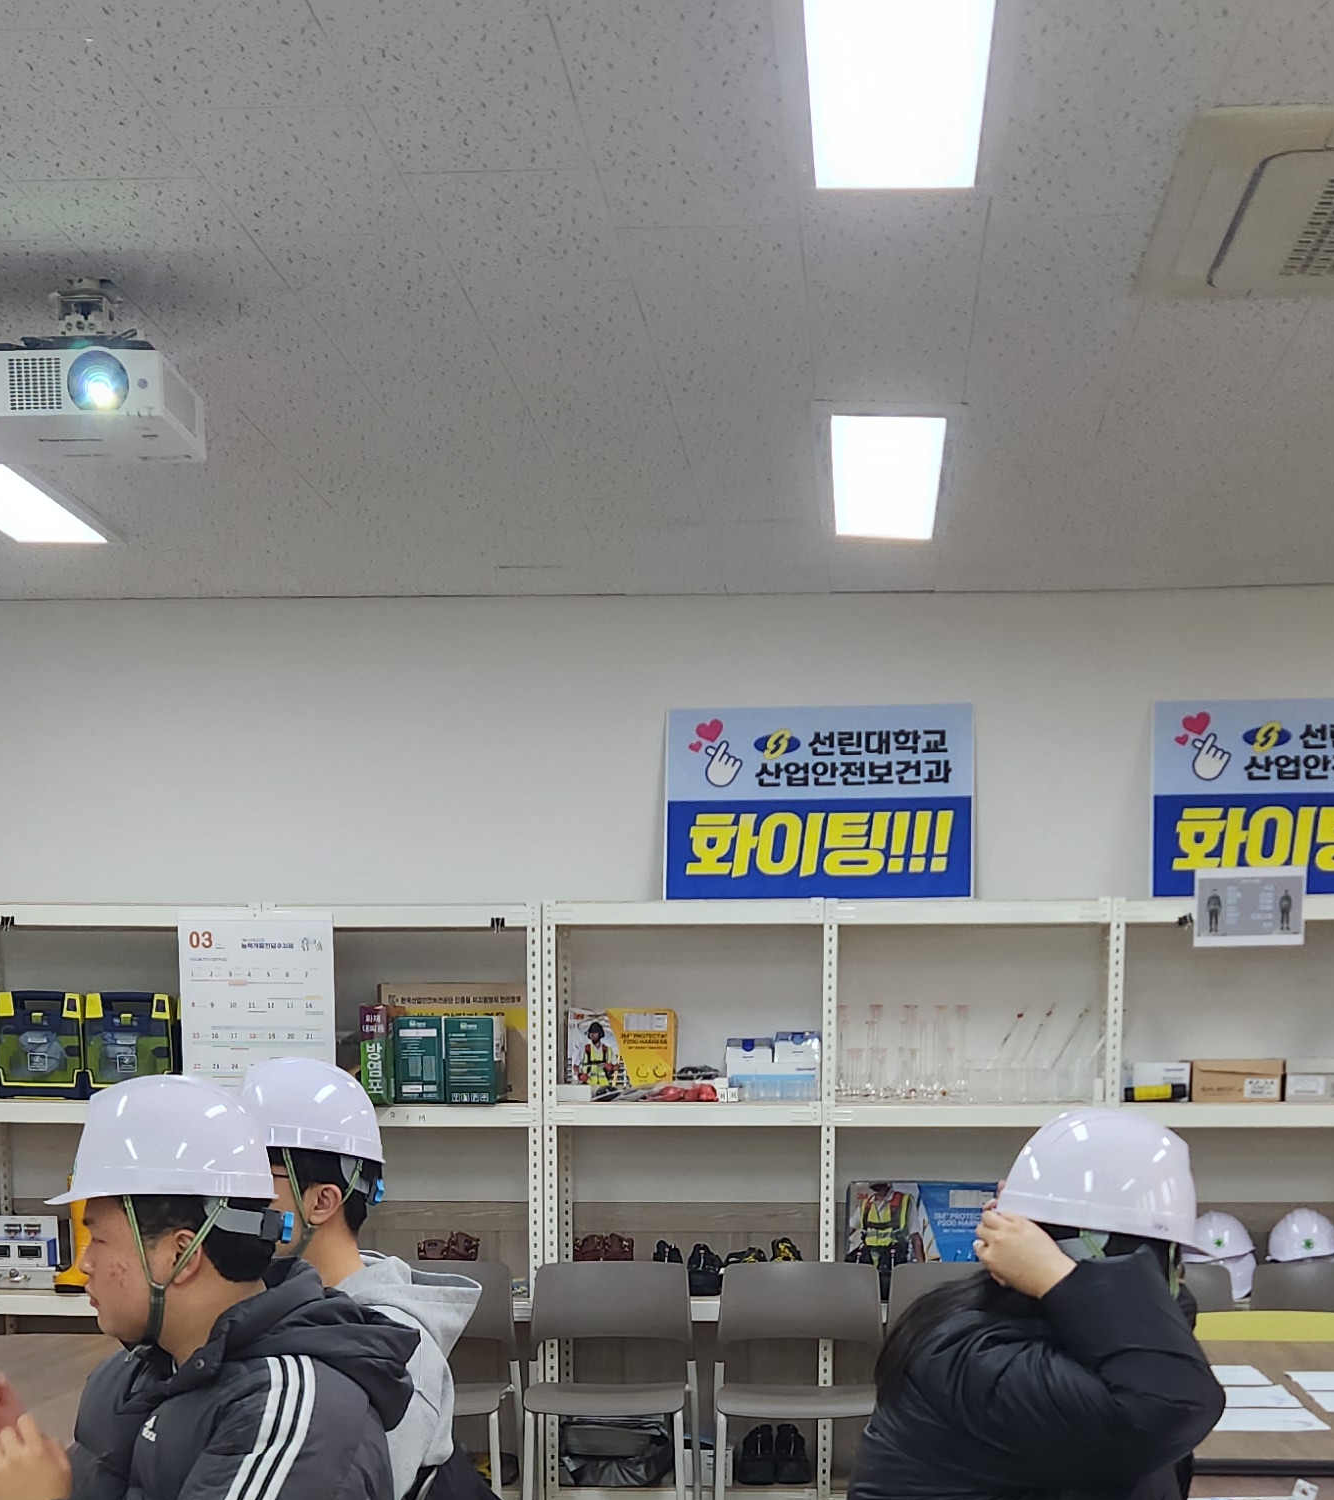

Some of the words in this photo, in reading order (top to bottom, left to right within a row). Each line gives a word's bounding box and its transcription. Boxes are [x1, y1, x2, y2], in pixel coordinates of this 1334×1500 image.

[809, 727, 948, 757] 선린대학교
[755, 753, 951, 787] 산업안전보건과
[686, 810, 953, 879] 화이팅!!!
[189, 931, 213, 949] 03
[365, 1014, 381, 1022] 화재
